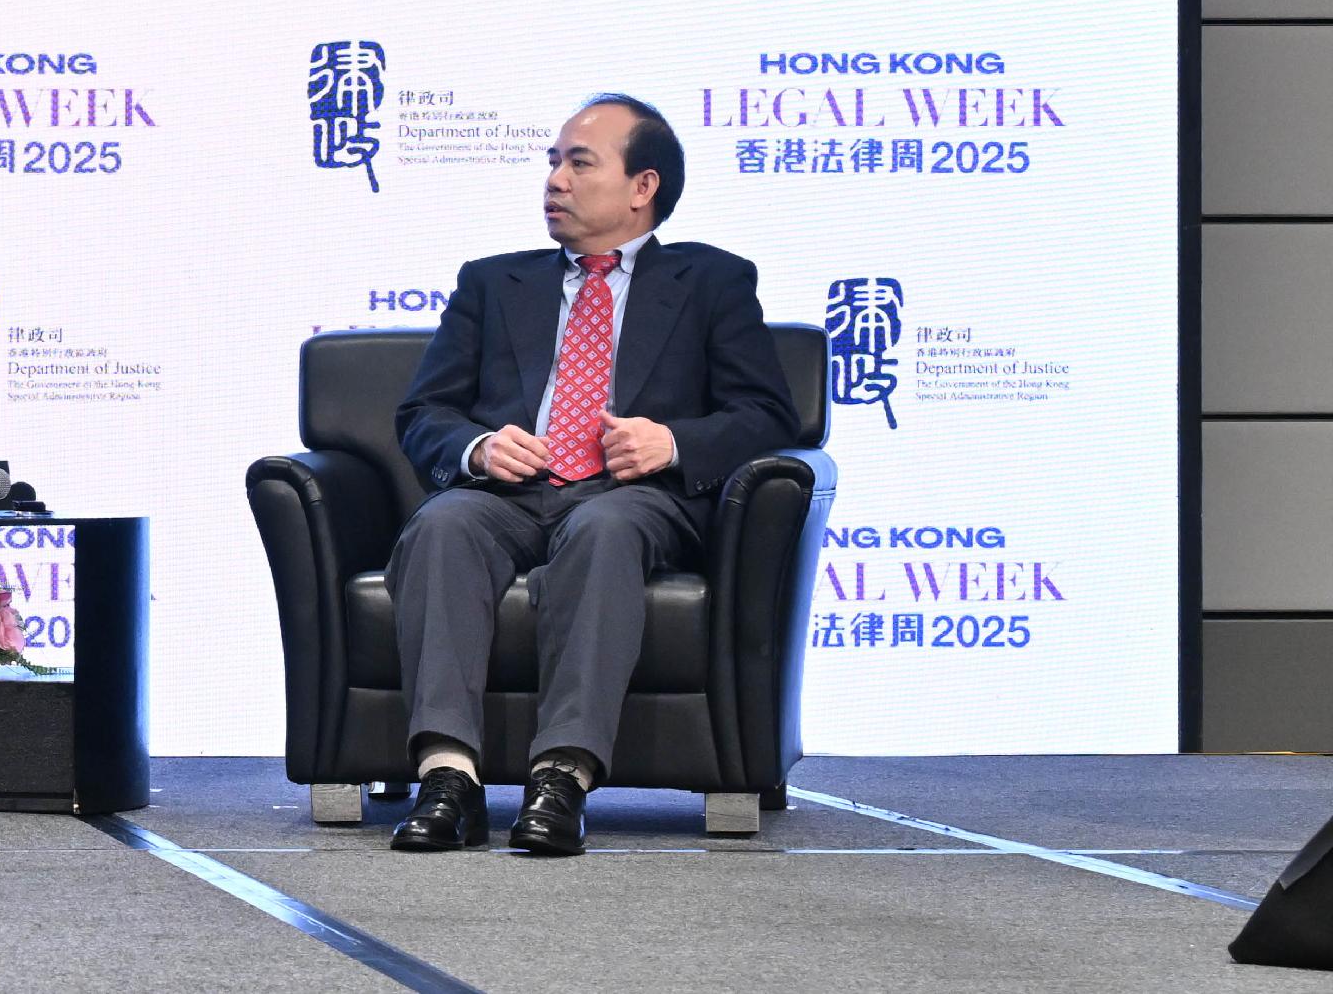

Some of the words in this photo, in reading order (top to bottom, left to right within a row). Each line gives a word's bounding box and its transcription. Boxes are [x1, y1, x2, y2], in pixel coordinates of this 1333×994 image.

[759, 51, 882, 76] HONG
[888, 51, 1007, 76] KONG
[700, 87, 887, 128] LEGAL
[900, 87, 1068, 128] WEEK
[734, 137, 1032, 175] 香港法律周2025
[368, 288, 451, 312] HON
[916, 327, 972, 344] 律政司
[915, 362, 998, 379] Department
[1003, 362, 1019, 376] of
[1021, 362, 1071, 376] Justice
[821, 526, 882, 550] NG
[888, 526, 1007, 550] KONG
[900, 561, 1068, 603] WEEK
[811, 611, 1032, 648] 法律周2025
